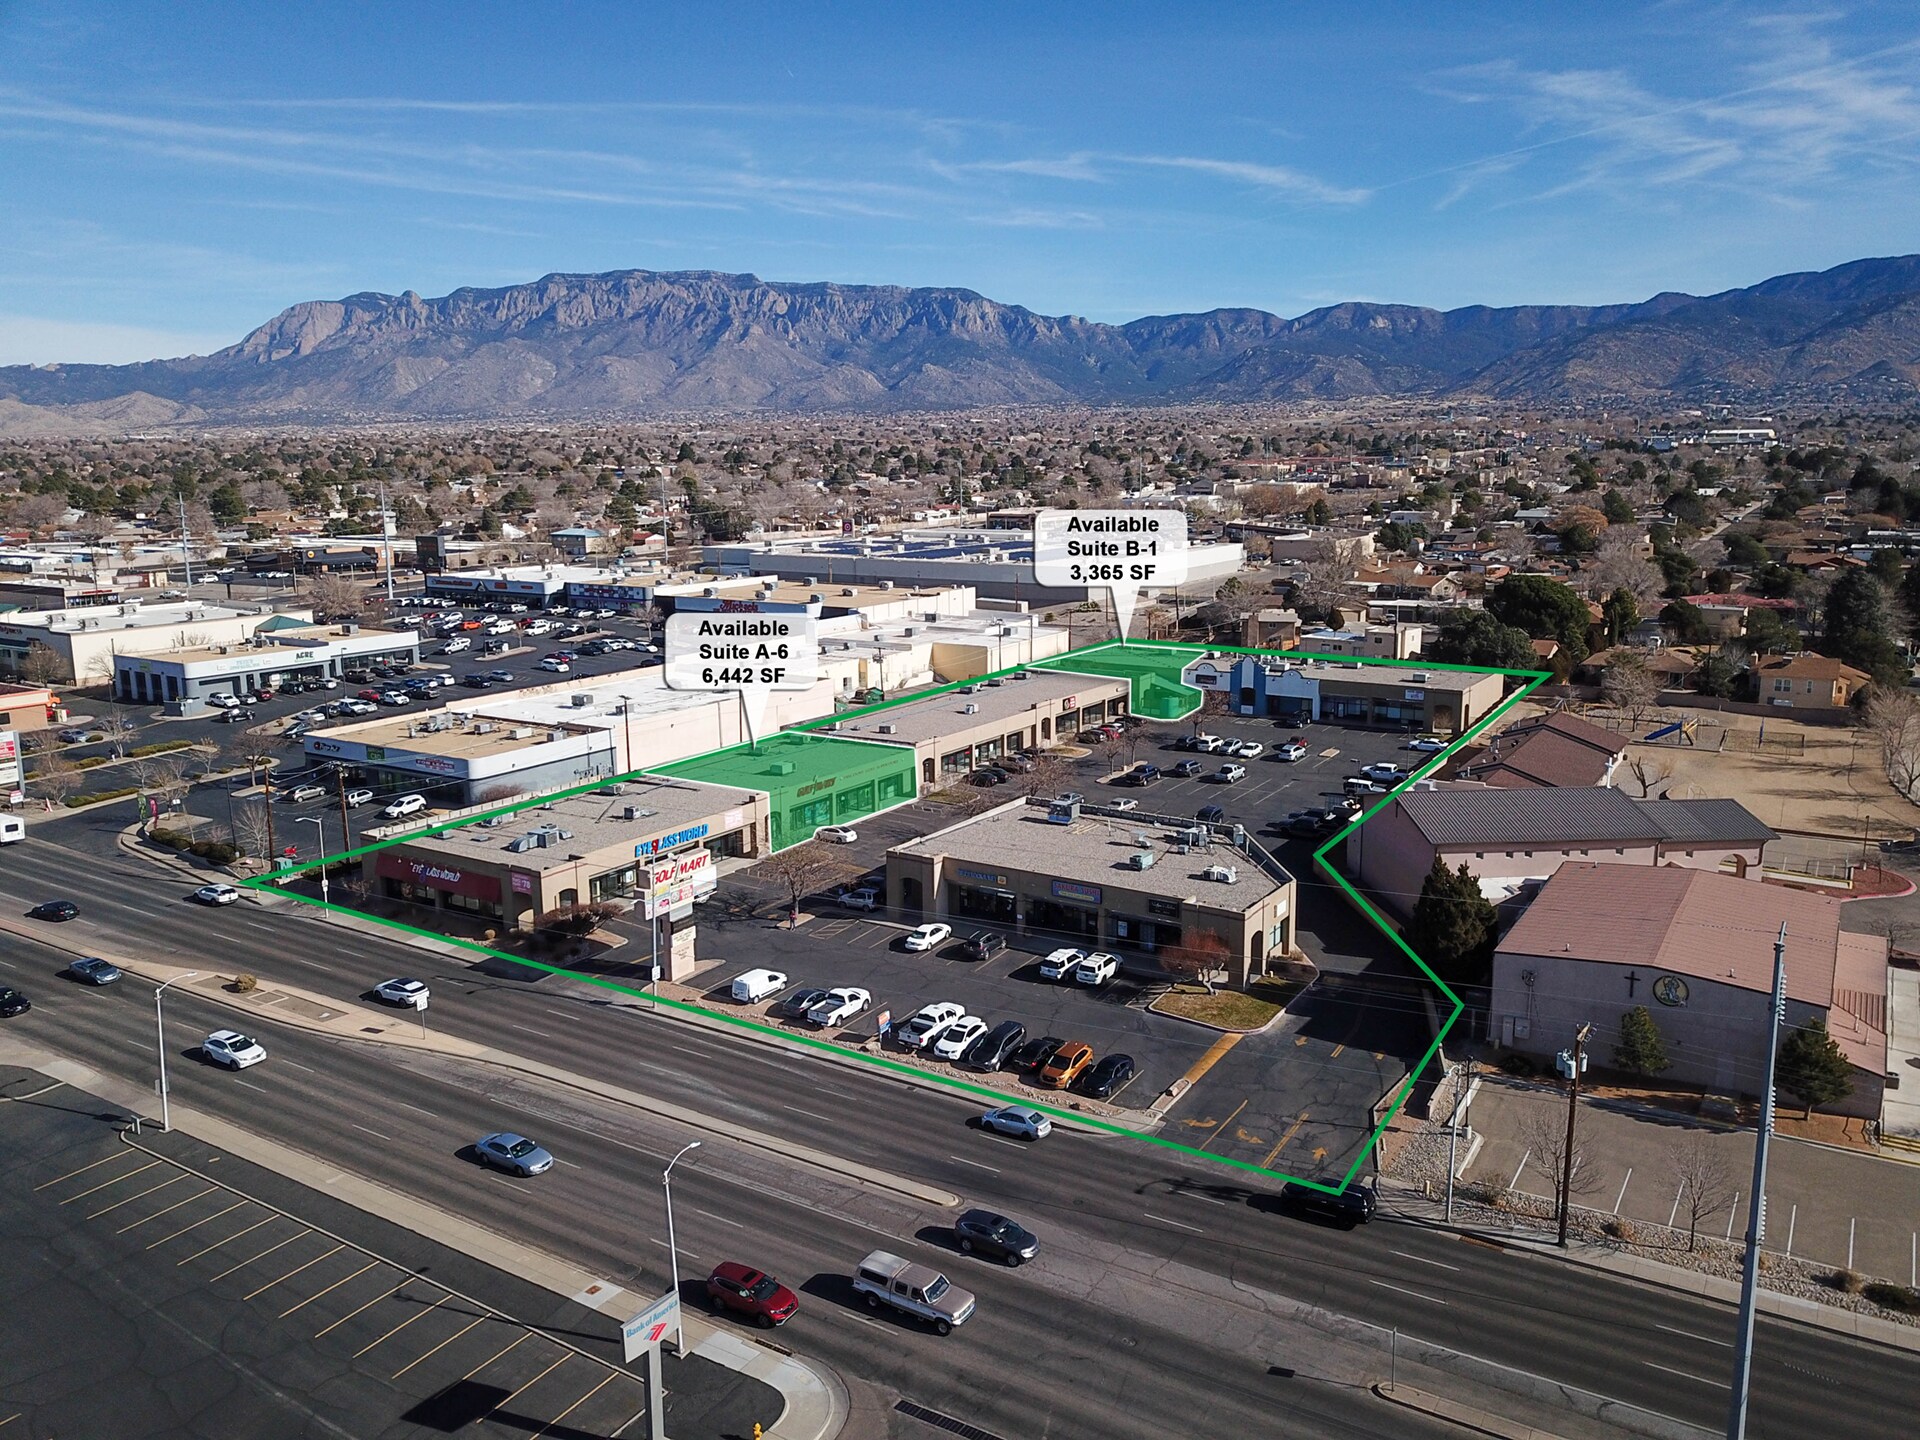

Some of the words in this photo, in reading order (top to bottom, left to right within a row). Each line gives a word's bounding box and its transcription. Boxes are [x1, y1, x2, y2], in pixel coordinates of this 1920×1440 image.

[295, 651, 314, 660] ACRE
[678, 823, 709, 843] WORLD
[679, 853, 710, 875] MART
[440, 869, 461, 882] WORLD
[626, 1322, 645, 1338] Bank
[652, 1299, 678, 1322] America
